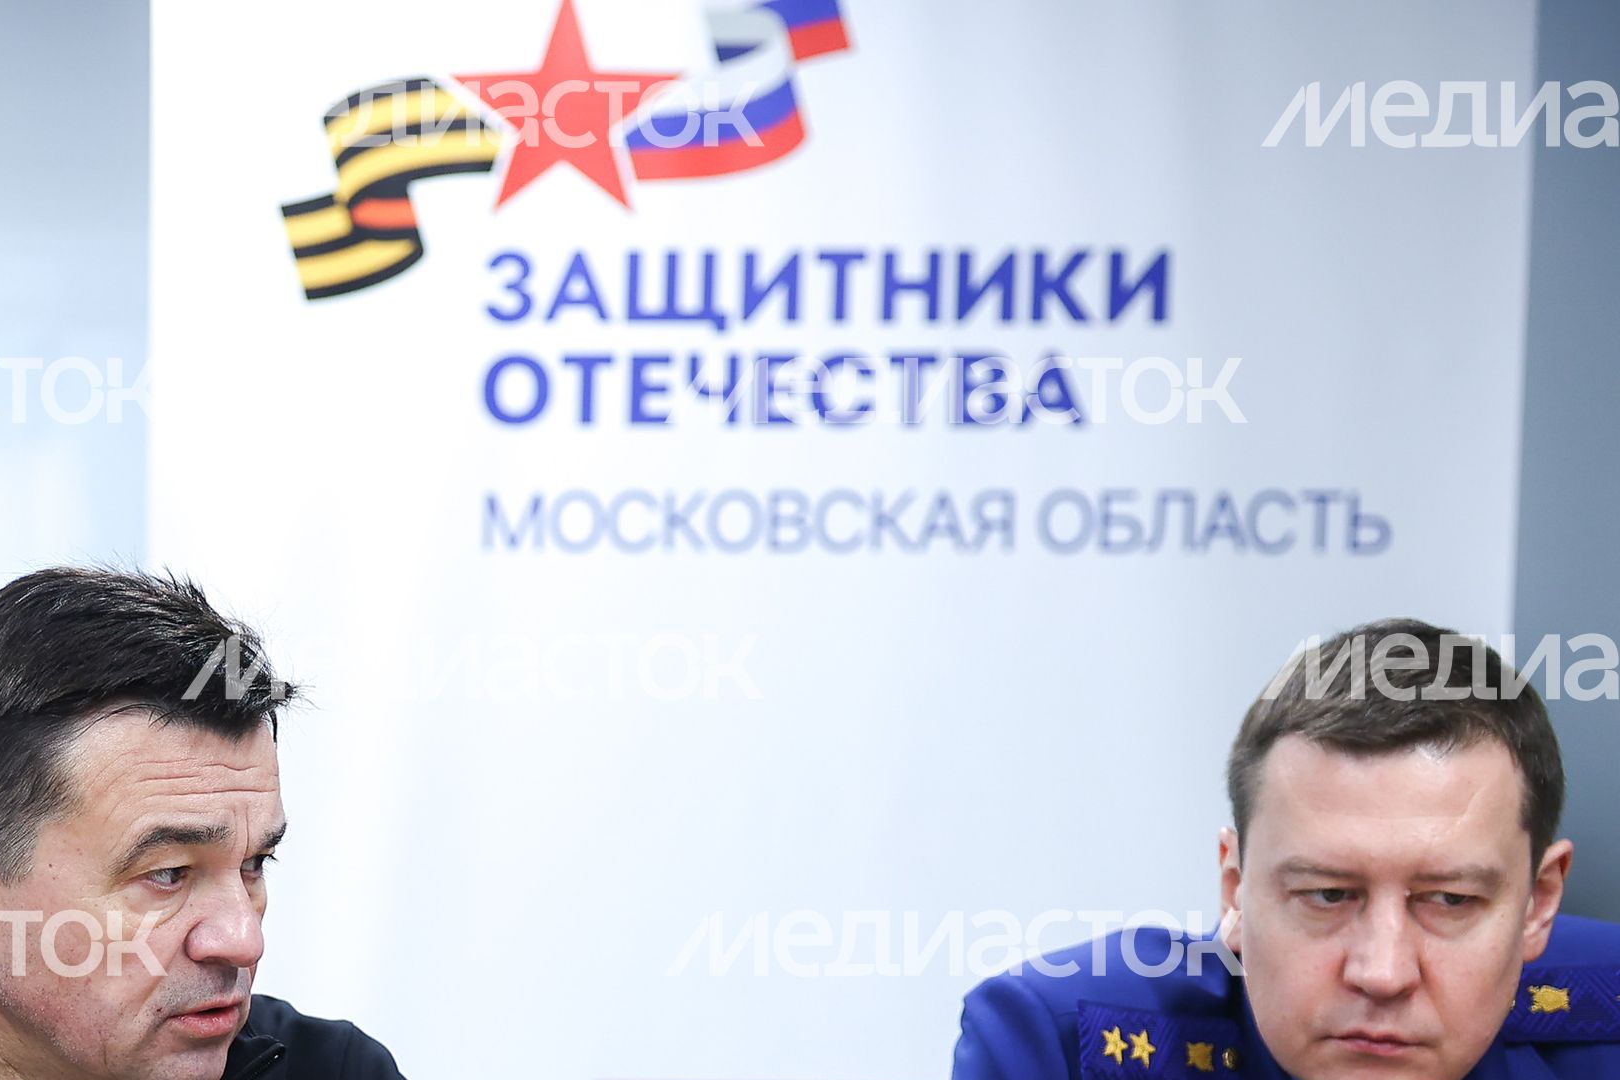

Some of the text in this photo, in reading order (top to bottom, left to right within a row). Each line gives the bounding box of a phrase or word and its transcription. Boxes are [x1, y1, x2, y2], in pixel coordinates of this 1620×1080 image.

[481, 248, 1176, 332] ЗАЩИТНИКИ
[480, 349, 1089, 427] ОТЕЧЕСТВА
[480, 488, 1394, 557] МОСКОВСКАЯ ОБЛАСТЬ
